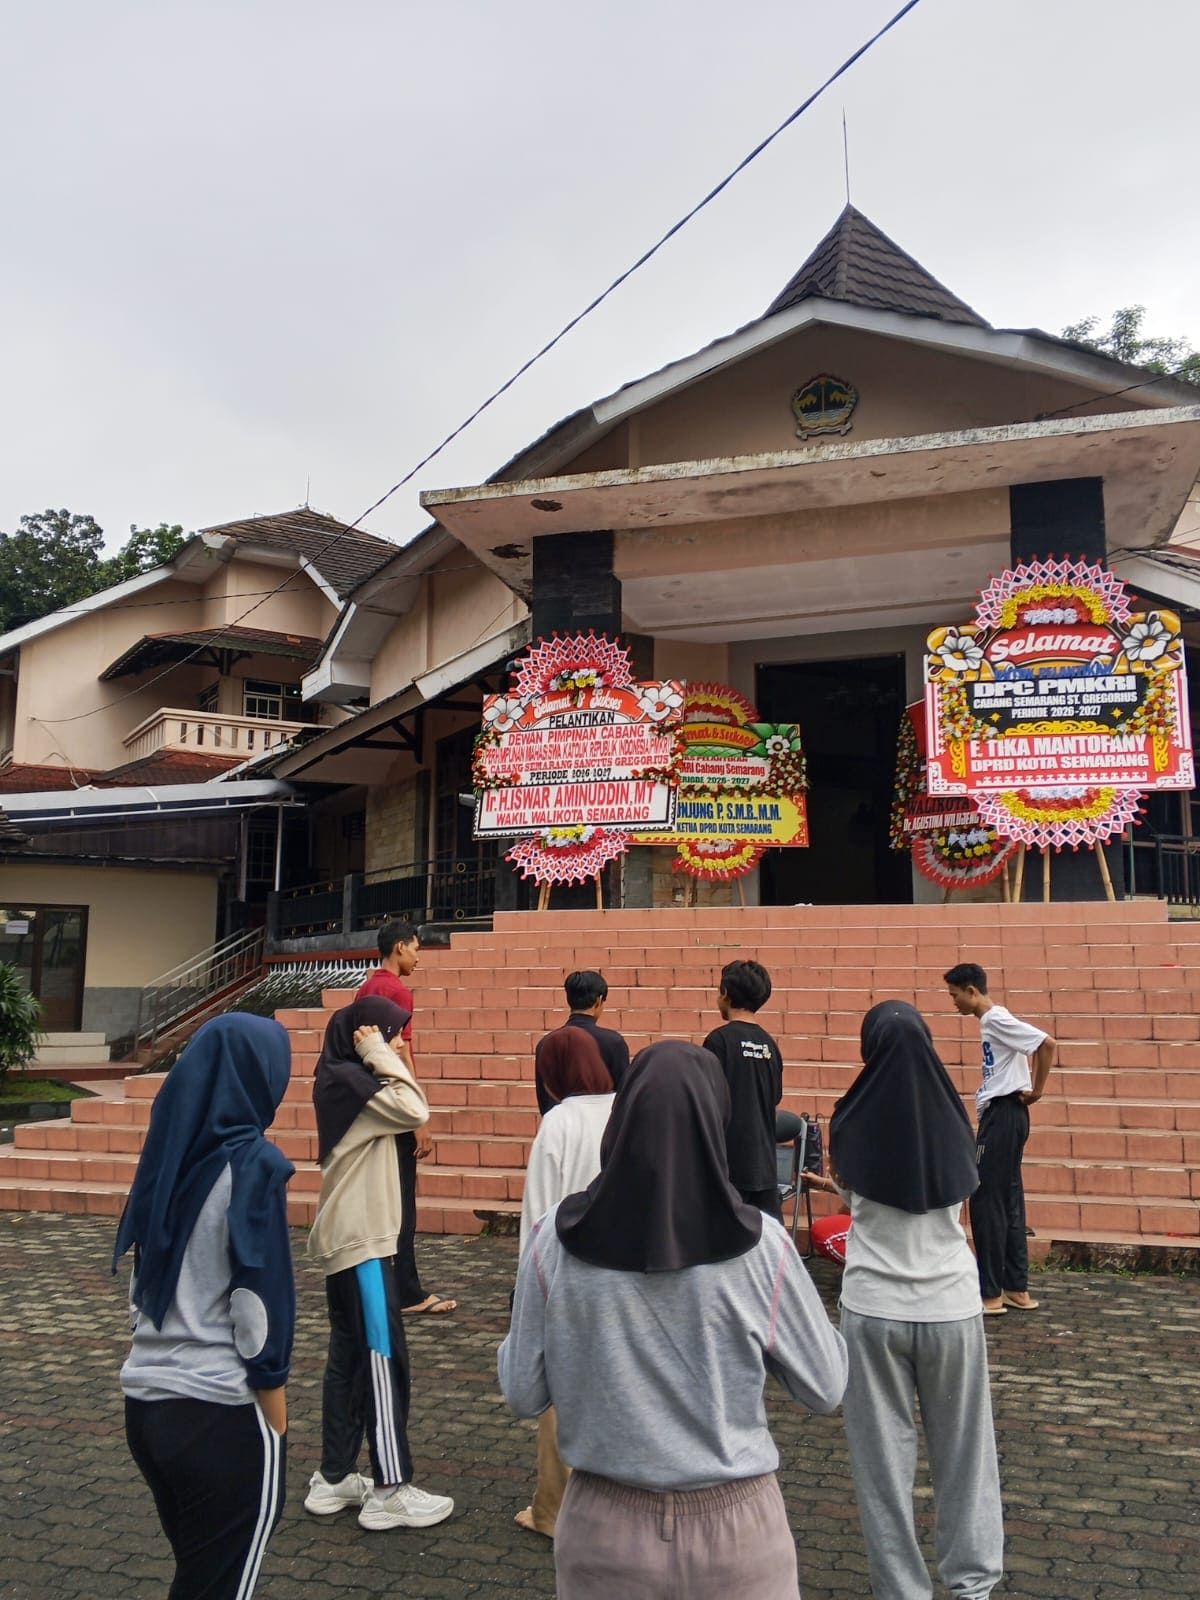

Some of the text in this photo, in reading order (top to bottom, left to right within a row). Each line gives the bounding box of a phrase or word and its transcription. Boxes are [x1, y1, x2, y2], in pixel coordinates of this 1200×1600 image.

[990, 632, 1117, 661] Selamat
[974, 680, 1035, 697] DPC
[1039, 675, 1136, 694] PMKRI
[973, 697, 1013, 709] CABANG
[1014, 694, 1066, 707] SEMARANG
[1082, 691, 1137, 704] GREGORIUS
[549, 711, 615, 728] PELANTIKAN
[1011, 707, 1048, 718] PERIODE
[508, 724, 645, 746] DEWAN PIMPINAN CABANG
[986, 738, 1031, 757] TIKA
[1033, 733, 1147, 755] MANTOFANY
[490, 755, 669, 774] CABANG SEMARANG SANCTUS GREGORIUS
[695, 762, 725, 775] Cabang
[726, 763, 765, 777] Semarang
[971, 753, 1149, 772] DPRD KOTA SEMARANG
[530, 770, 568, 780] PERIODE
[496, 806, 650, 826] WAKIL WALIKOTA SEMARANG
[677, 822, 772, 834] KETUA DPRD KOTA SEMARANG
